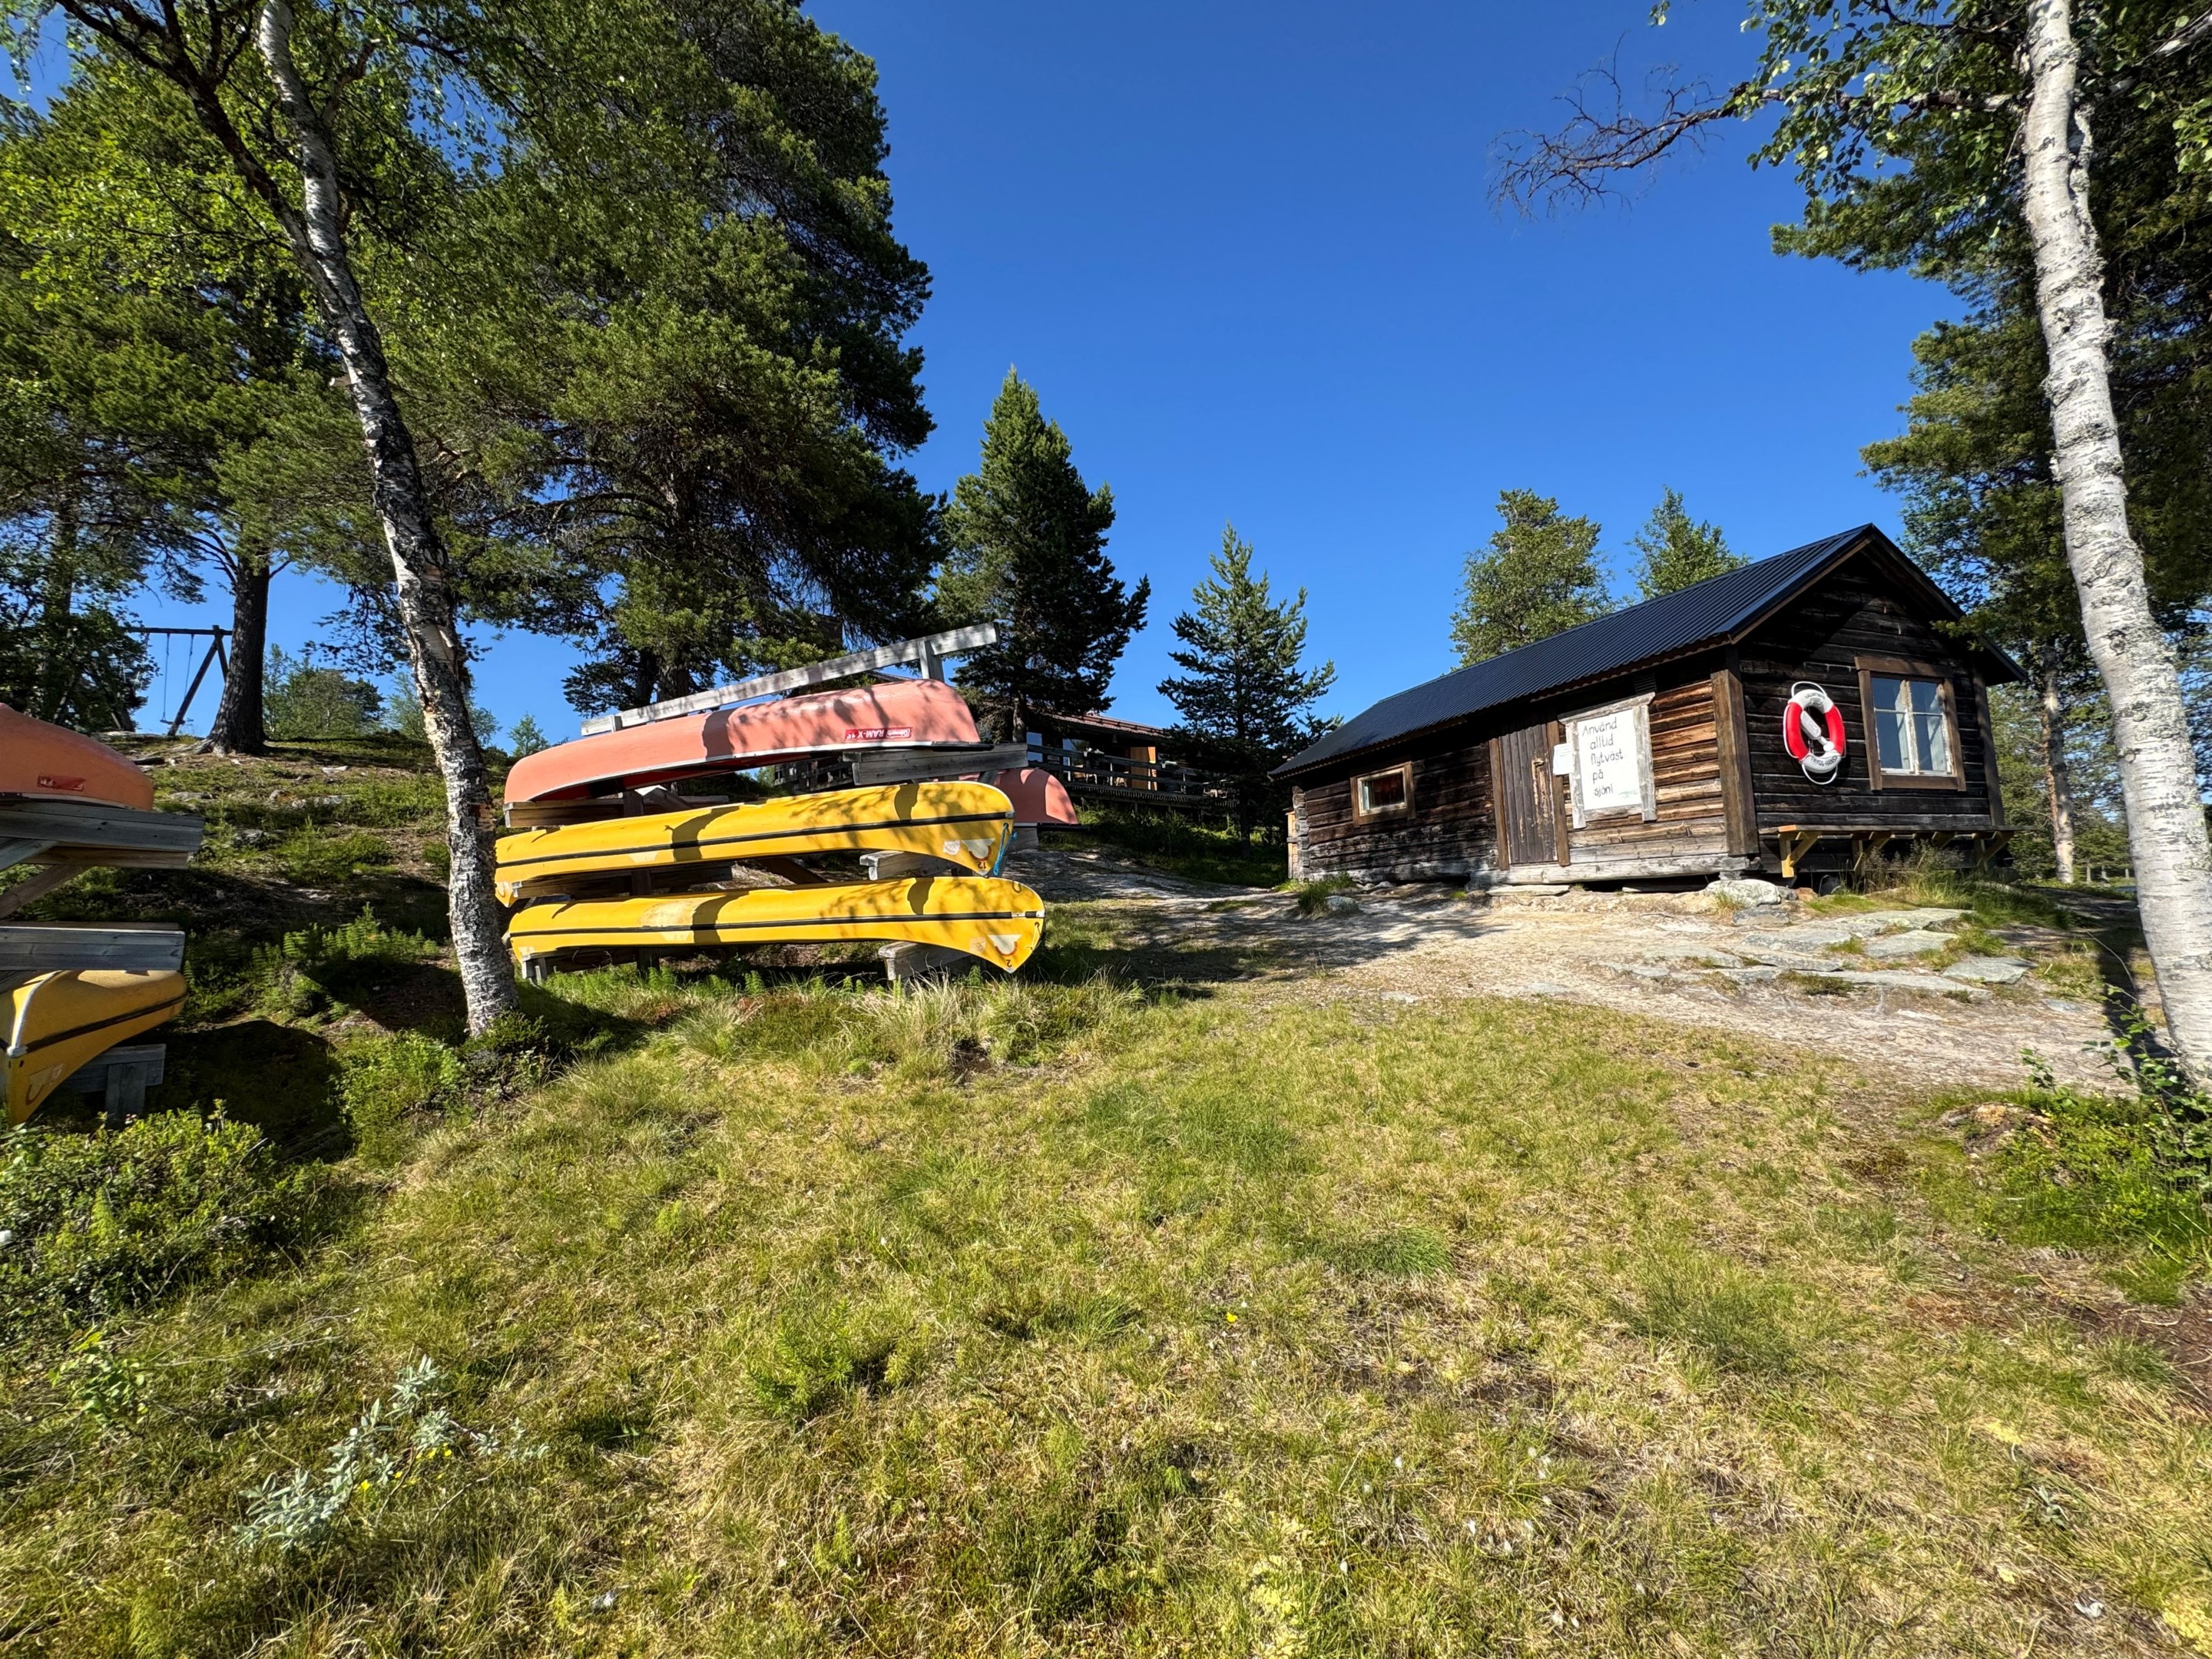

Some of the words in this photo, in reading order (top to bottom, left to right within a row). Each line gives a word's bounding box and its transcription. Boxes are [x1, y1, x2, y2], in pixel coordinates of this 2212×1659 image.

[1582, 717, 1617, 737] Använd
[857, 729, 884, 738] RAM-X
[1590, 733, 1614, 750] alltid
[1592, 769, 1604, 783] på
[977, 861, 987, 869] 12
[1005, 959, 1012, 968] 2
